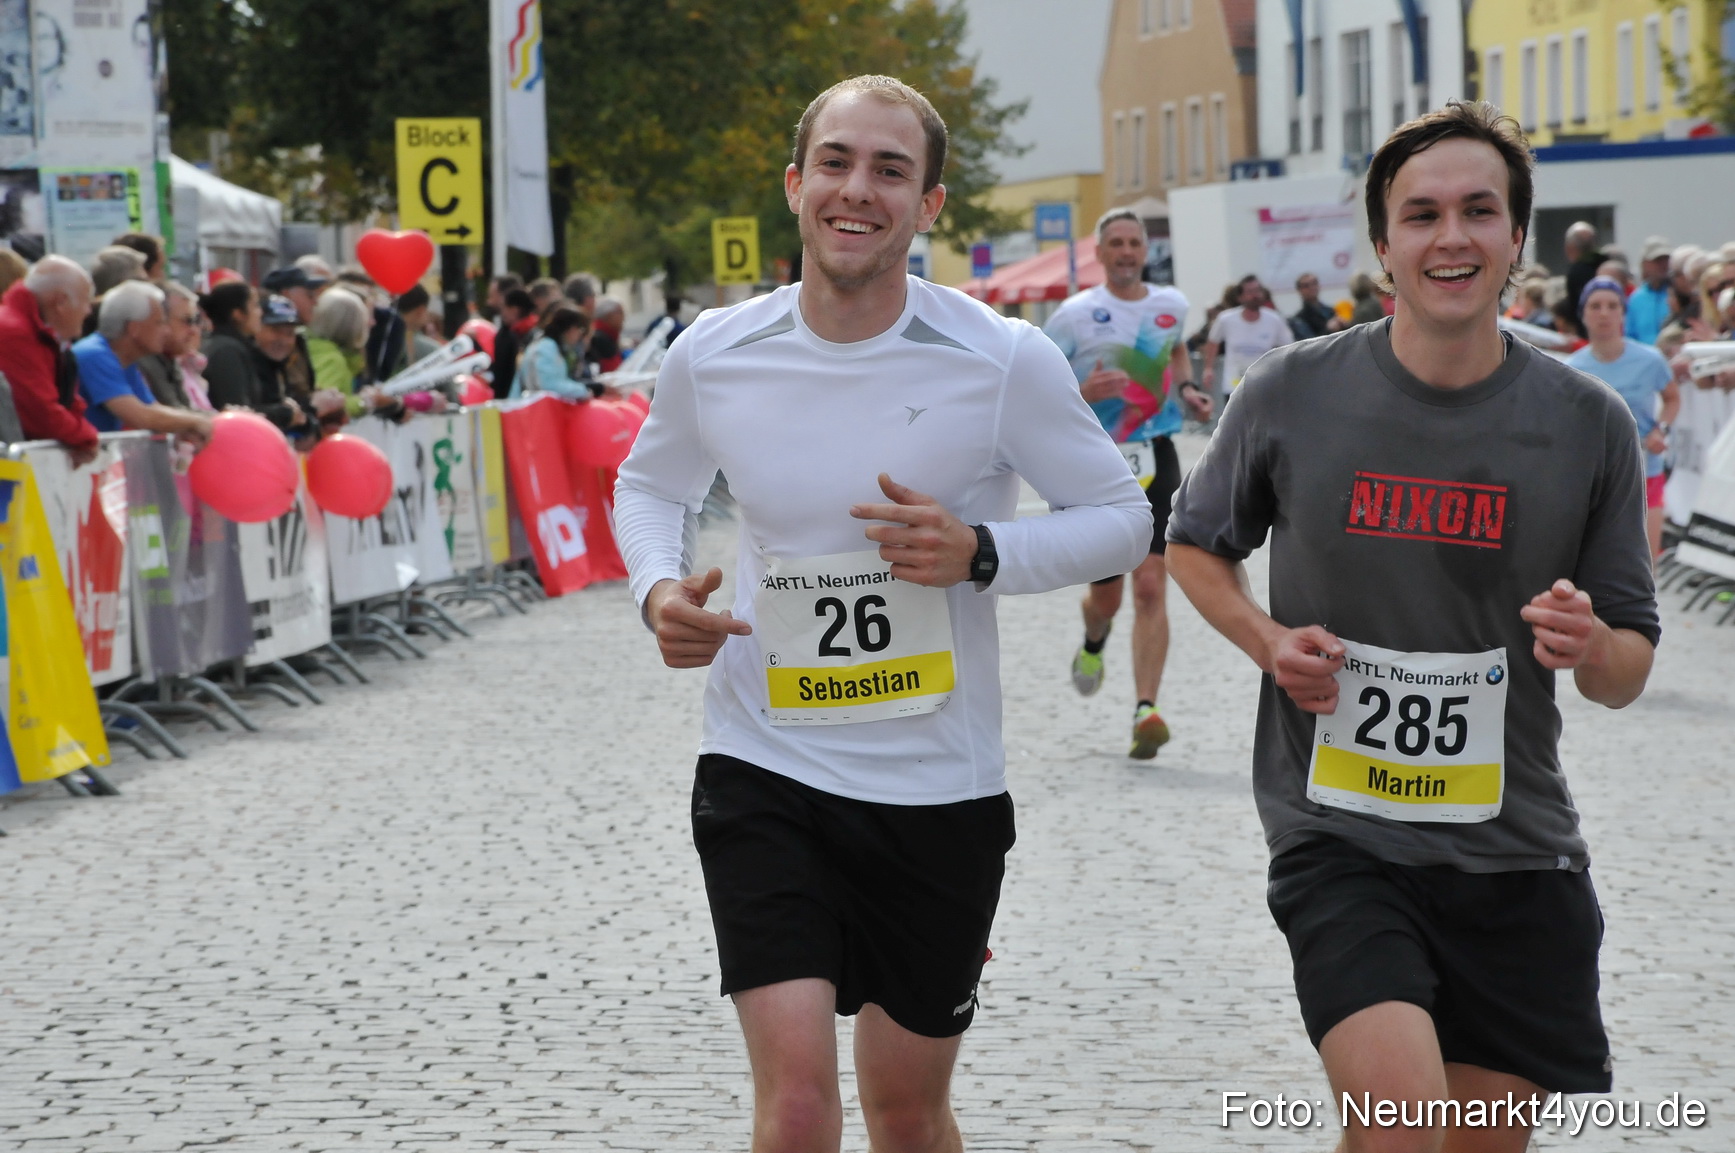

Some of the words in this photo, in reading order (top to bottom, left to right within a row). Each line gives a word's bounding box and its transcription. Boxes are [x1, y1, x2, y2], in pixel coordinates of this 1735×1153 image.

[407, 125, 470, 147] Block
[420, 157, 459, 216] C
[726, 239, 748, 270] D
[1129, 453, 1141, 476] 3
[1349, 480, 1507, 540] NIXON
[818, 570, 896, 589] Neumar
[814, 594, 892, 658] 26
[798, 670, 920, 701] Sebastian
[1390, 667, 1480, 687] Neumarkt
[1354, 686, 1470, 757] 285
[1367, 765, 1446, 797] Martin
